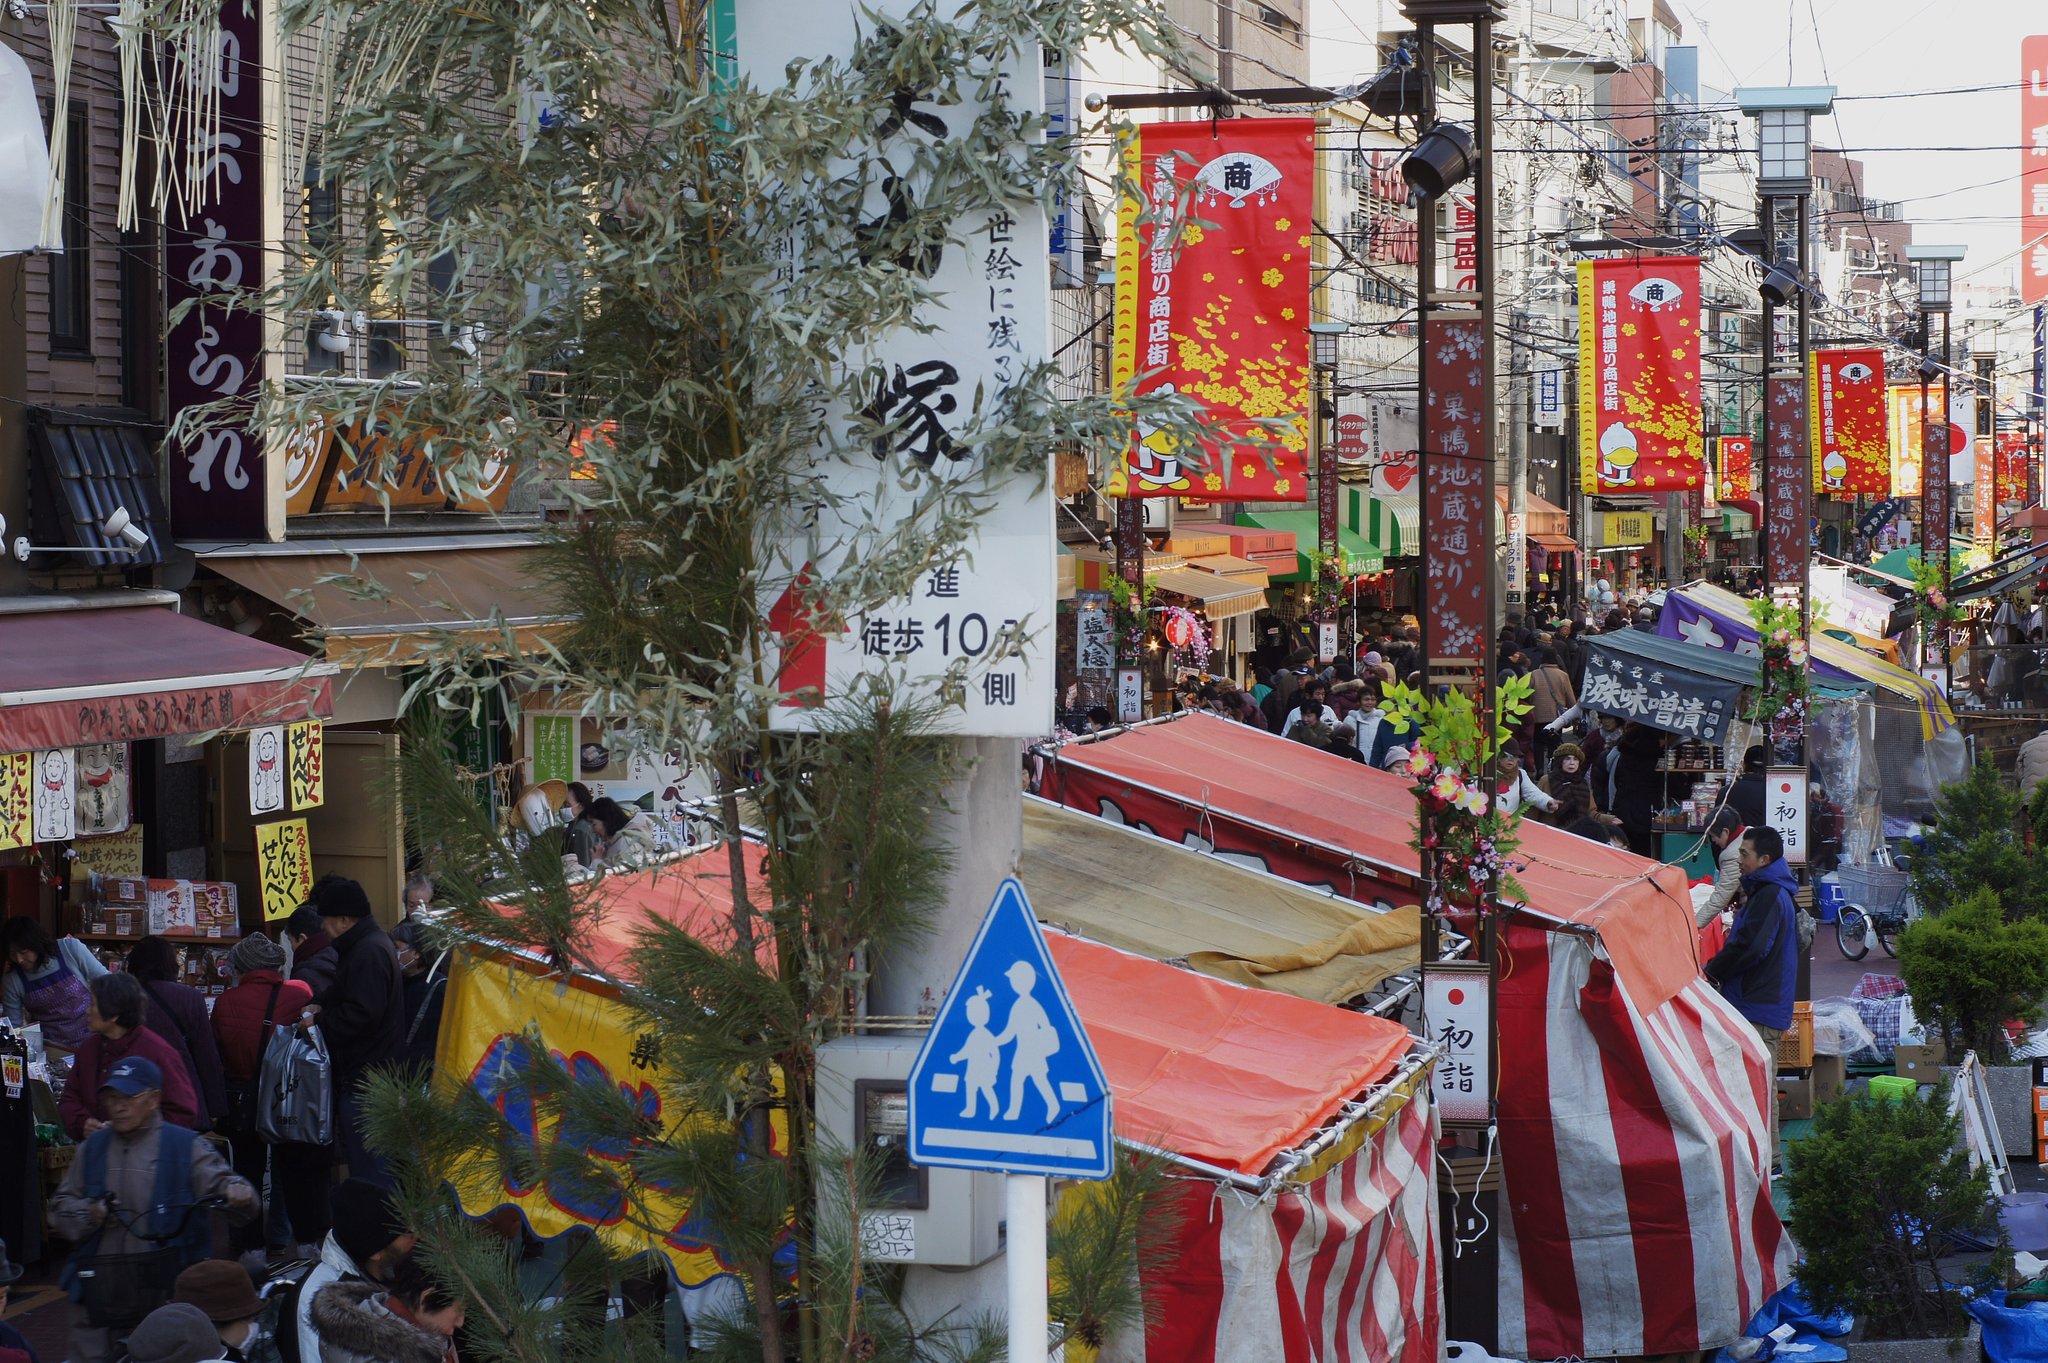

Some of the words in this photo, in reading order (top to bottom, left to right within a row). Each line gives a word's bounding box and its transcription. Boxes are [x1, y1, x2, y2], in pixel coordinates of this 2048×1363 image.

[1224, 161, 1253, 191] 商
[1645, 282, 1664, 302] 商
[1601, 279, 1619, 411] 巣鴨地蔵通り商店街
[1849, 366, 1862, 379] 商
[1821, 364, 1835, 445] 巣鴨地蔵通り商店街
[1439, 392, 1471, 589] 巣鴨地蔵通り
[1775, 421, 1796, 541] 巣鴨地蔵通り
[1589, 653, 1665, 686] 越後名産
[10, 753, 28, 847] にんにく
[291, 729, 308, 805] せんべい
[306, 722, 322, 804] にんにく
[262, 839, 285, 915] せんべい
[279, 825, 298, 905] にんにく
[1437, 1018, 1475, 1094] 初詣
